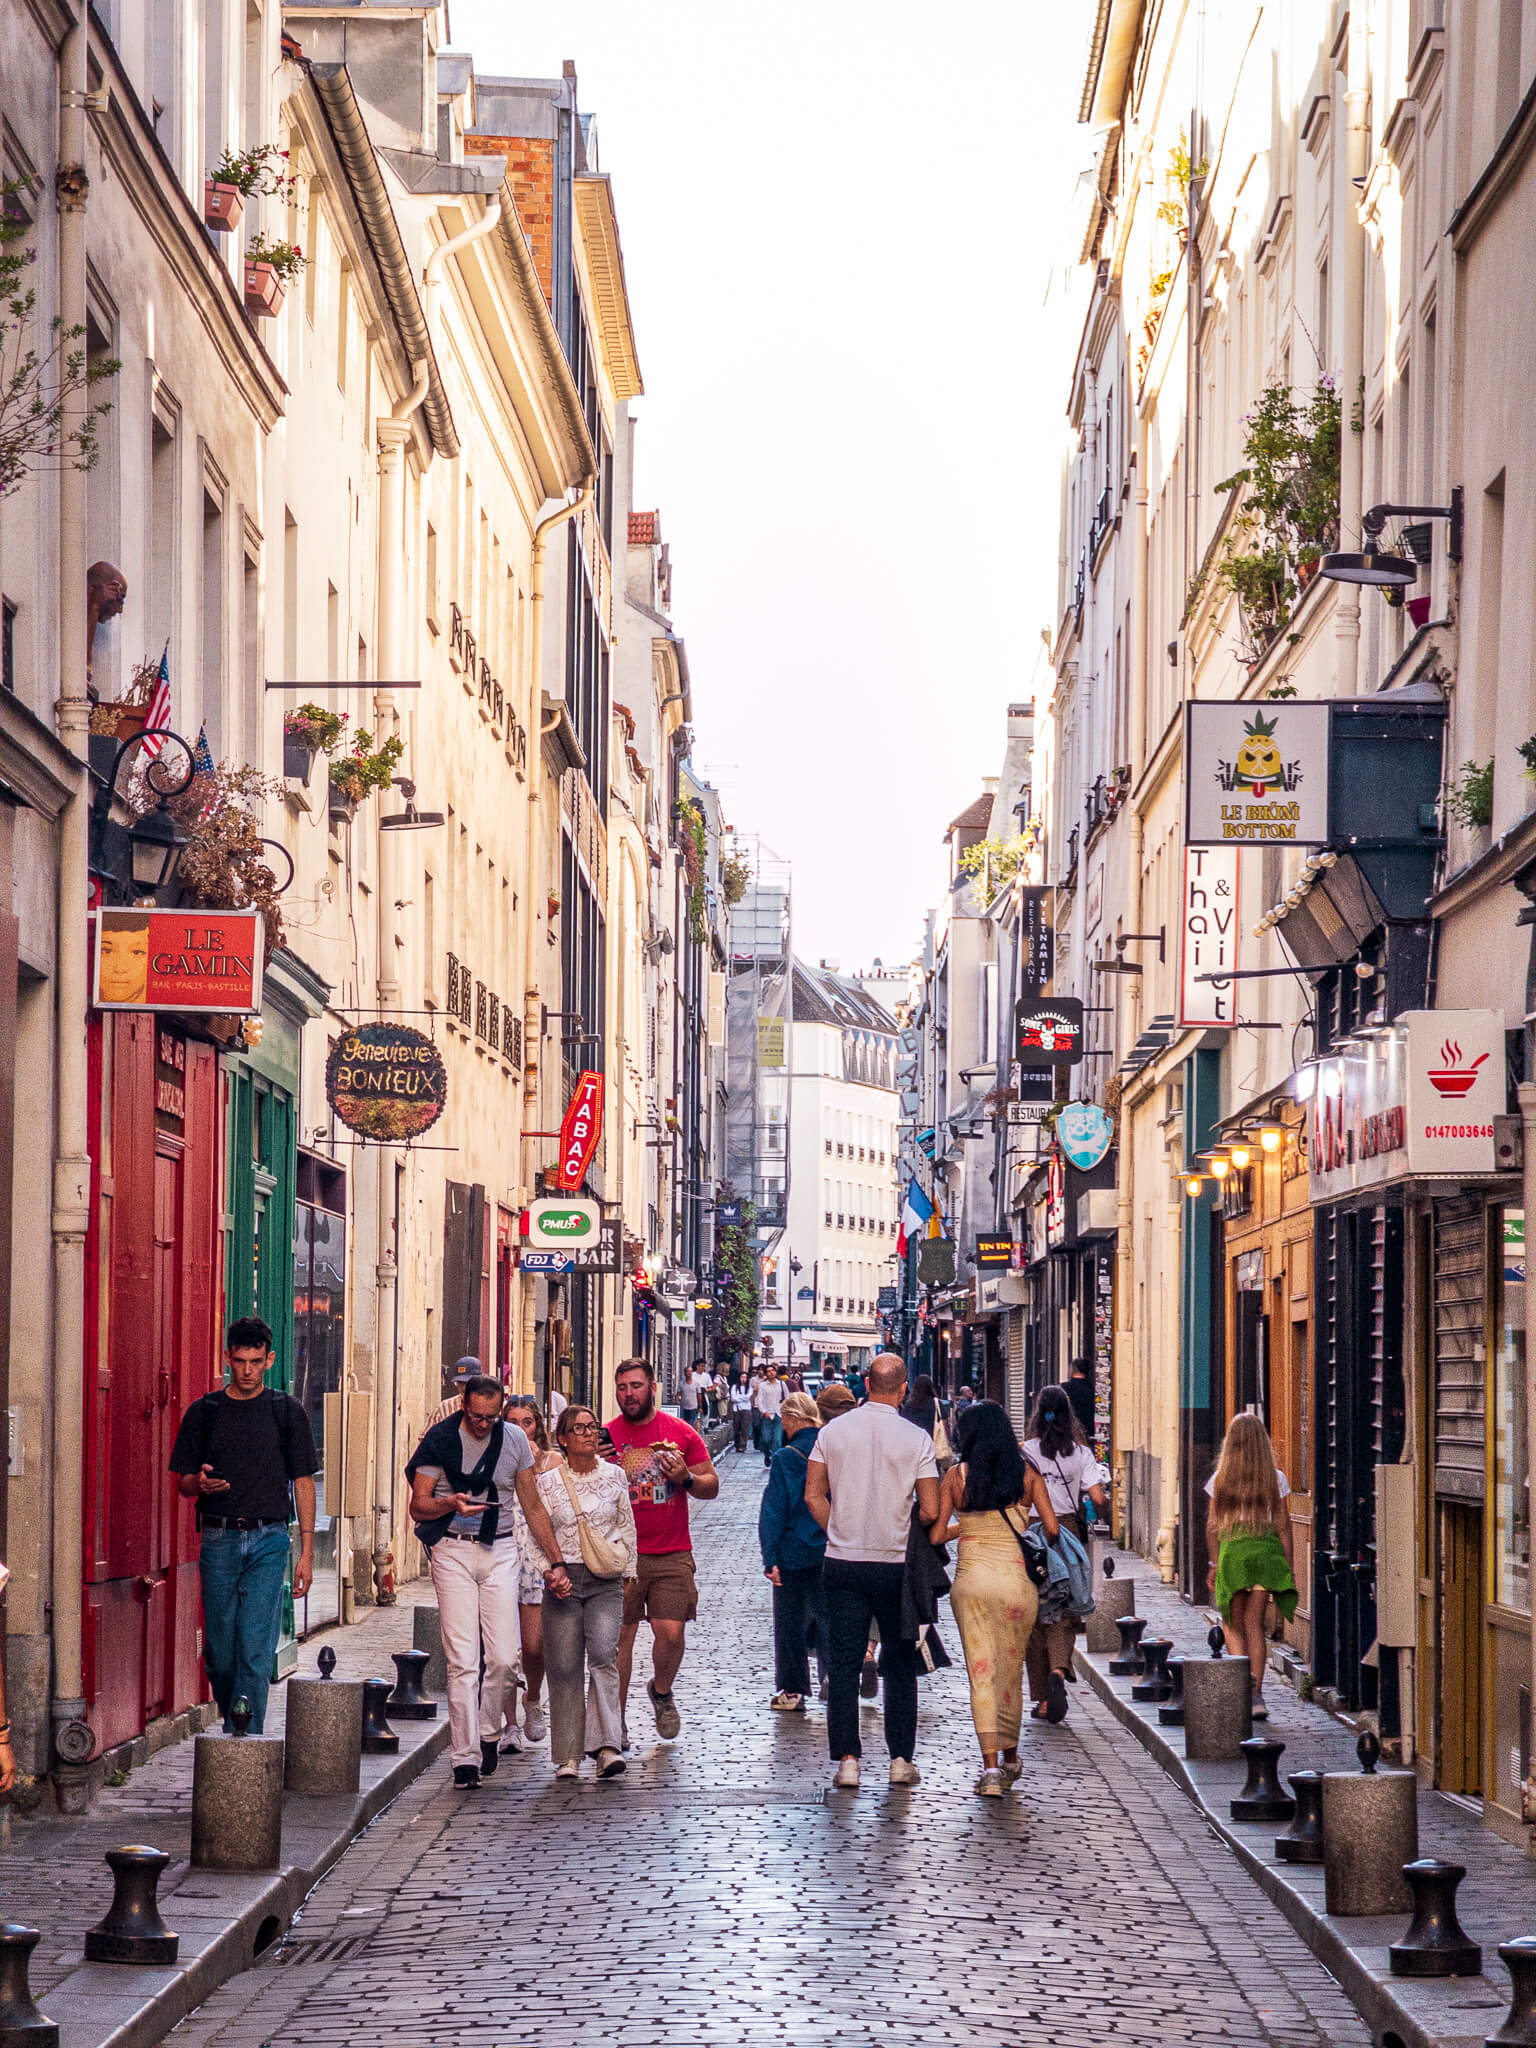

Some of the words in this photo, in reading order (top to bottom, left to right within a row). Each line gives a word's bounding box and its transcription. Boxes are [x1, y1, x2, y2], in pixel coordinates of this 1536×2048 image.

[1221, 804, 1242, 820] LE
[1246, 801, 1300, 820] BIKINI
[1223, 823, 1296, 838] BOTTOM
[1214, 879, 1231, 897] &
[1188, 849, 1208, 966] Thai
[184, 928, 225, 951] LE
[1027, 900, 1035, 984] RESTAURANT
[1039, 900, 1048, 984] VIETNAMIEN
[151, 953, 254, 977] GAMIN
[564, 1083, 597, 1177] TABAC
[1425, 1125, 1494, 1139] 0147003646
[541, 1219, 569, 1230] PMU
[527, 1255, 548, 1265] FDJ
